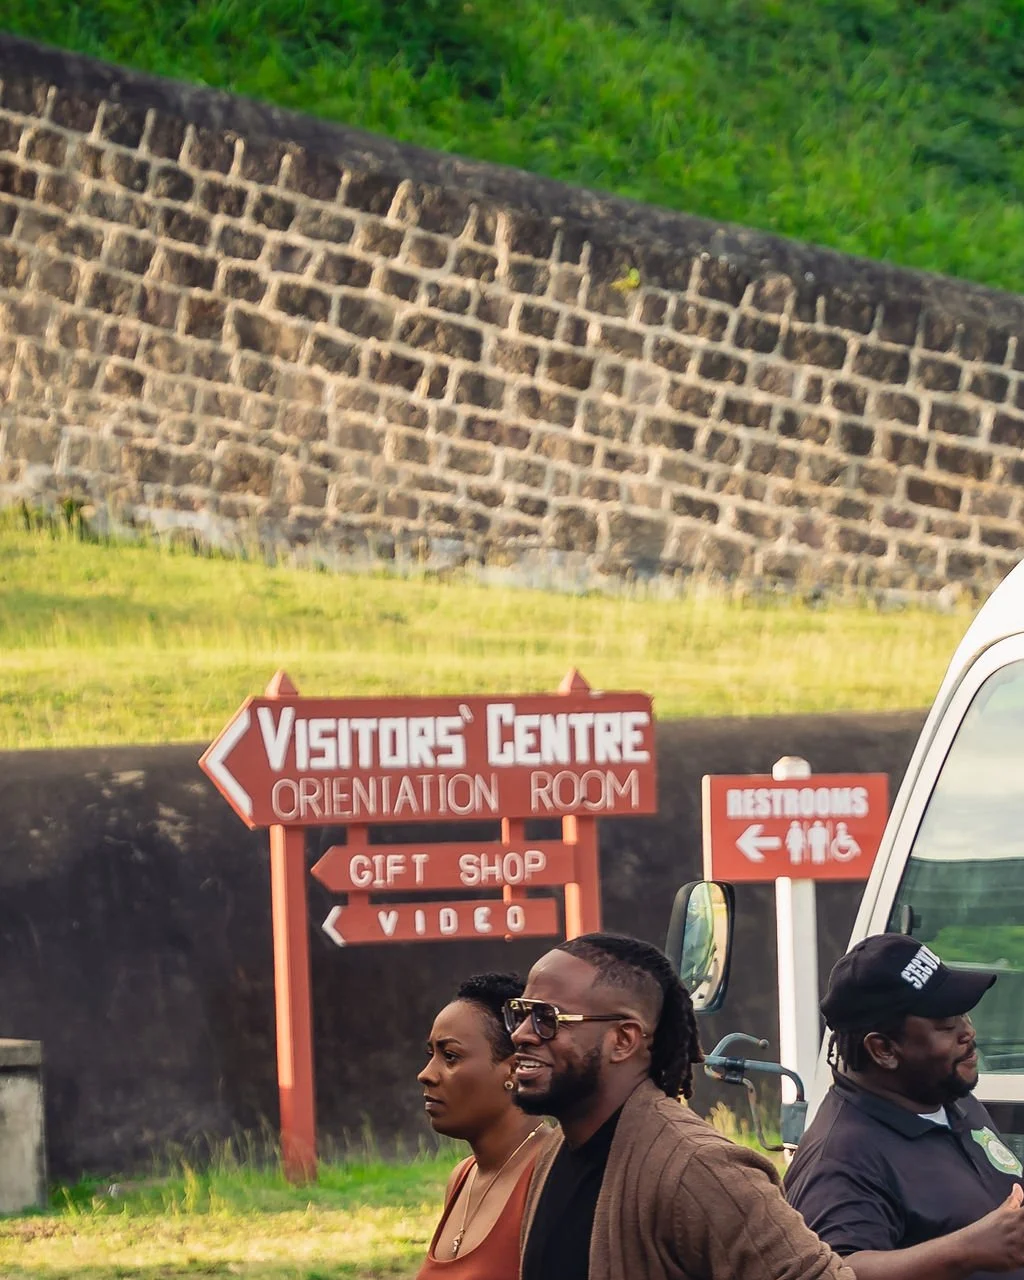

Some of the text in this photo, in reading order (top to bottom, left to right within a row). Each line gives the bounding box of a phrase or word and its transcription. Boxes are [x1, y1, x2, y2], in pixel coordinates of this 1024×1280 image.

[487, 703, 651, 766] CENTRE
[271, 768, 639, 820] ORIENTATION ROOM
[726, 786, 869, 819] RESTROOMS
[350, 850, 547, 888] GIFT SHOP
[377, 905, 525, 937] VIDEO
